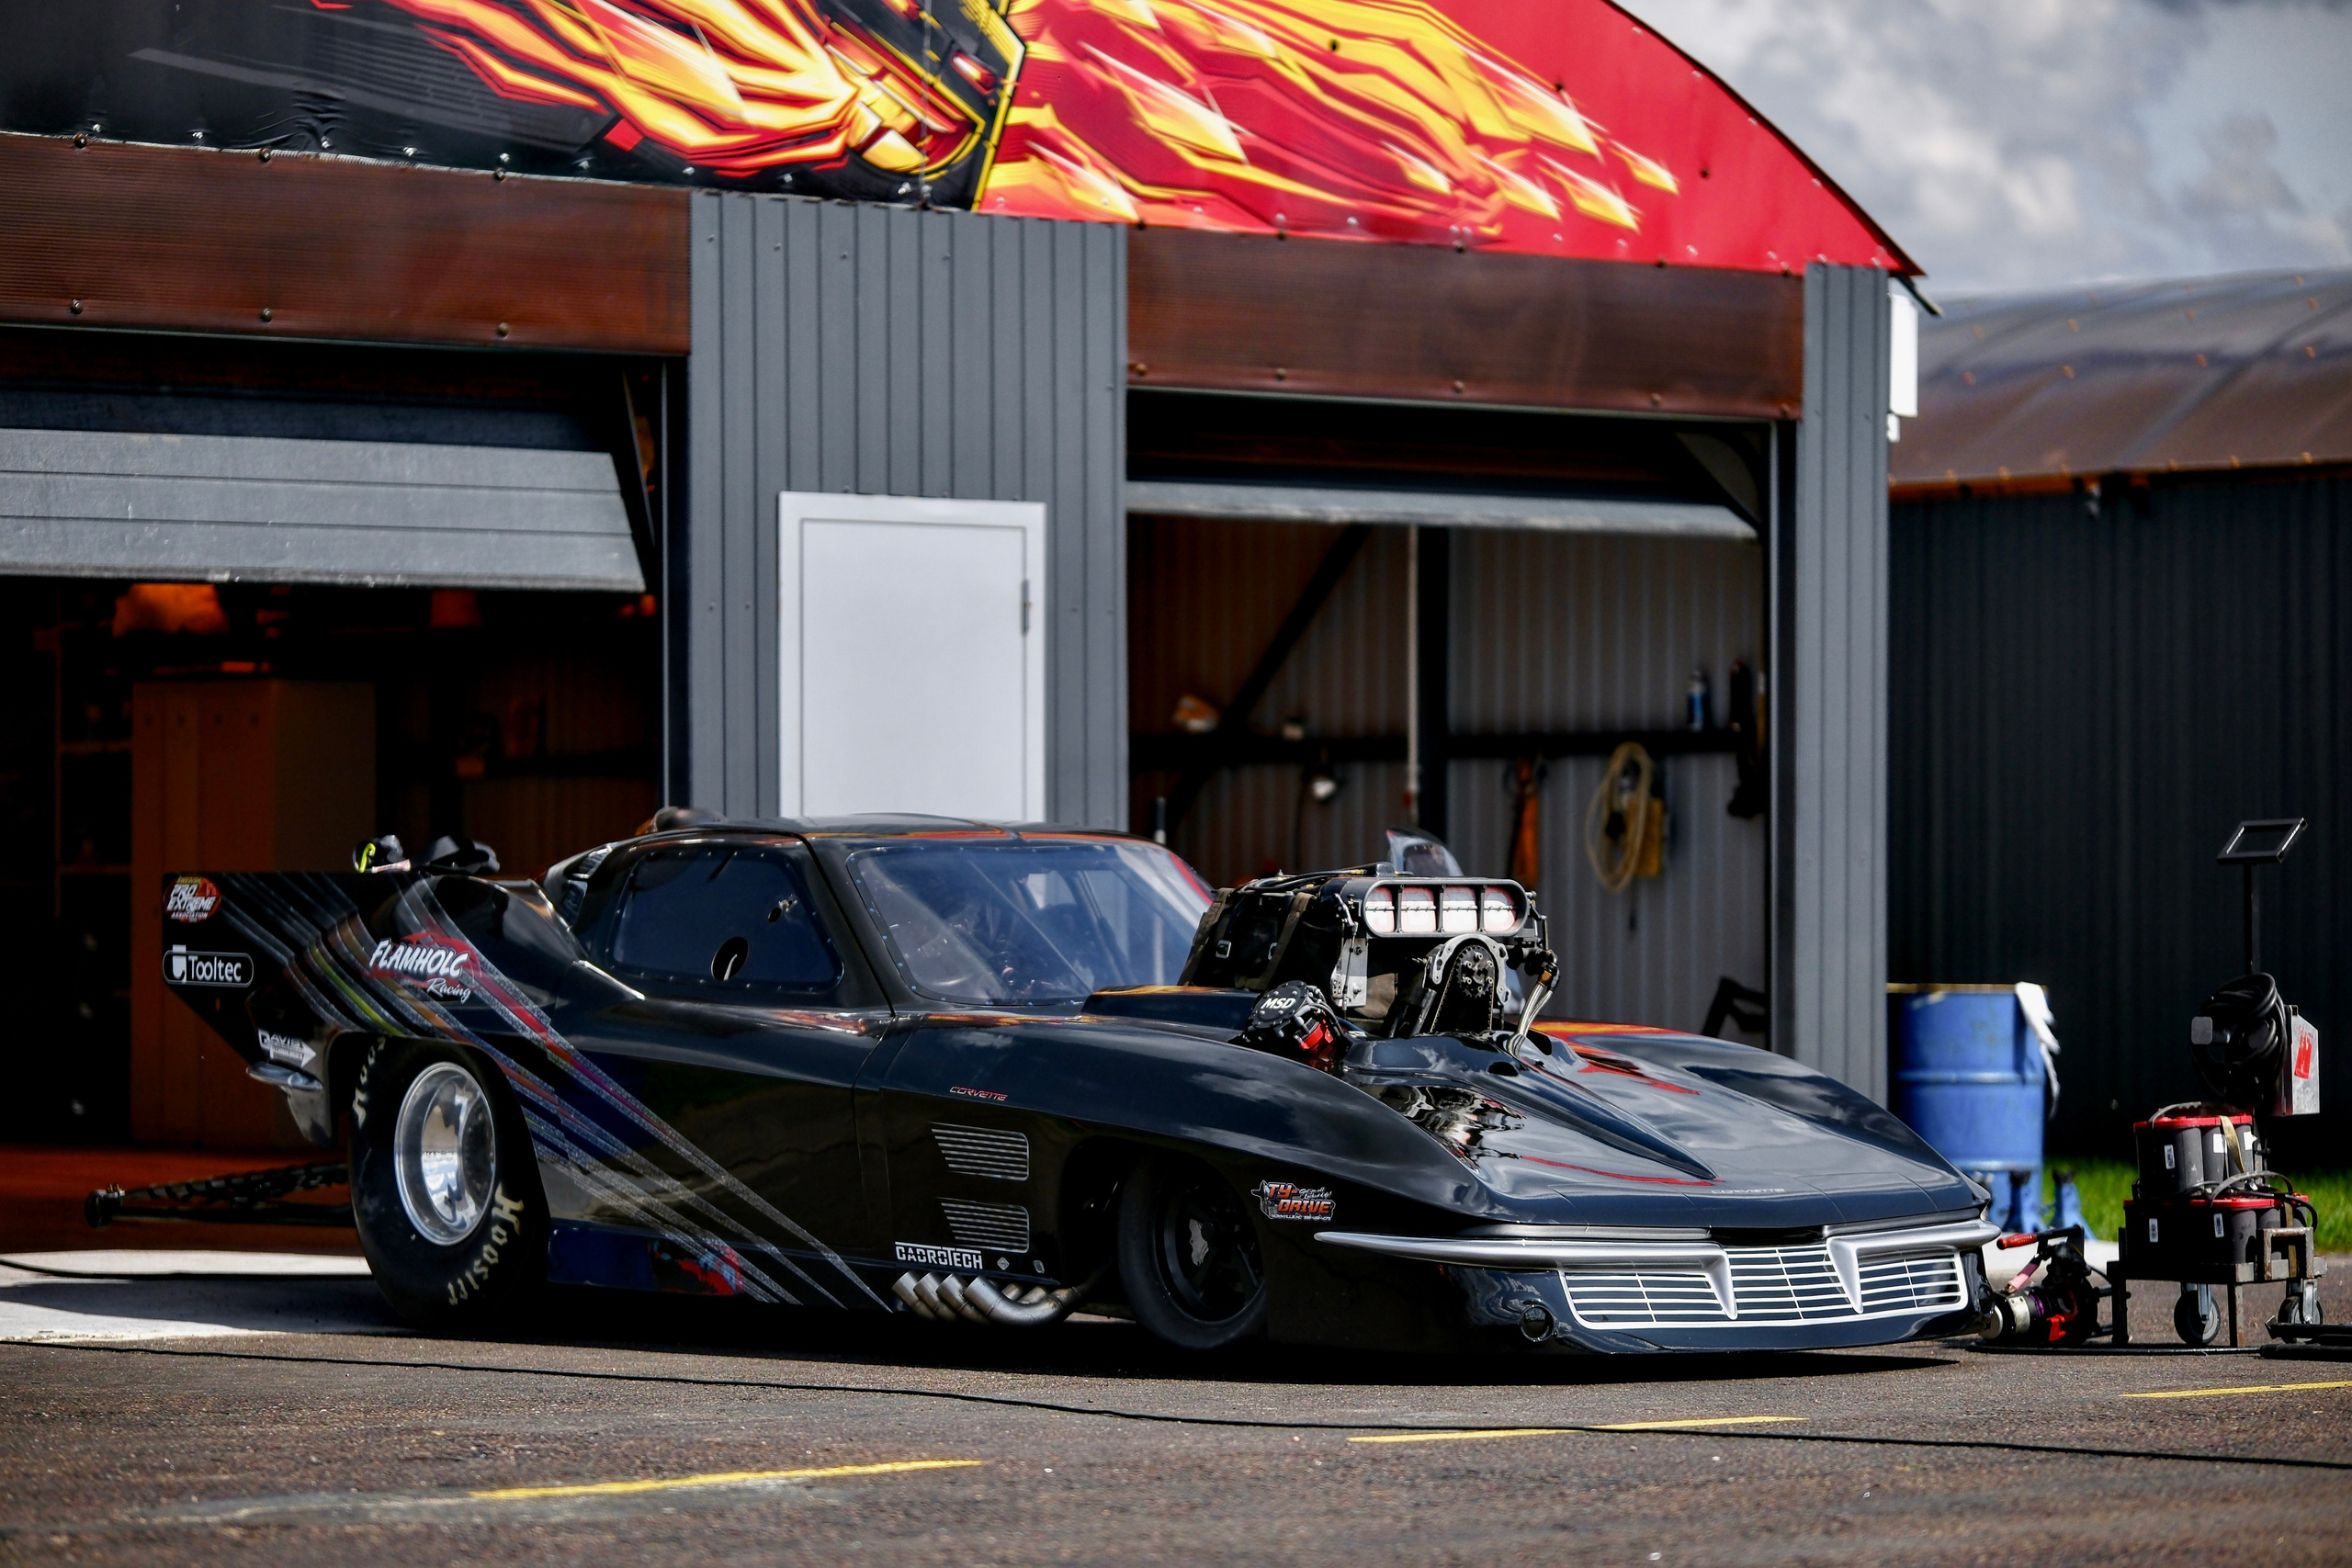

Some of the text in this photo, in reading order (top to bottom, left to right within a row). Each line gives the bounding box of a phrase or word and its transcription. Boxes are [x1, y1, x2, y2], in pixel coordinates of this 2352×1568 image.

[171, 884, 198, 897] PRO
[166, 897, 216, 911] EXTREME
[171, 911, 209, 919] ASSOCIATION
[368, 938, 469, 977] FLAMHOLC
[187, 955, 242, 982] Tooltec
[426, 977, 471, 1004] Racing
[1261, 998, 1296, 1009] MSD
[258, 1029, 300, 1050] DAVIS
[949, 1086, 1008, 1101] CORVETTE
[1268, 1184, 1298, 1198] TY-
[1278, 1199, 1331, 1213] DRIVE
